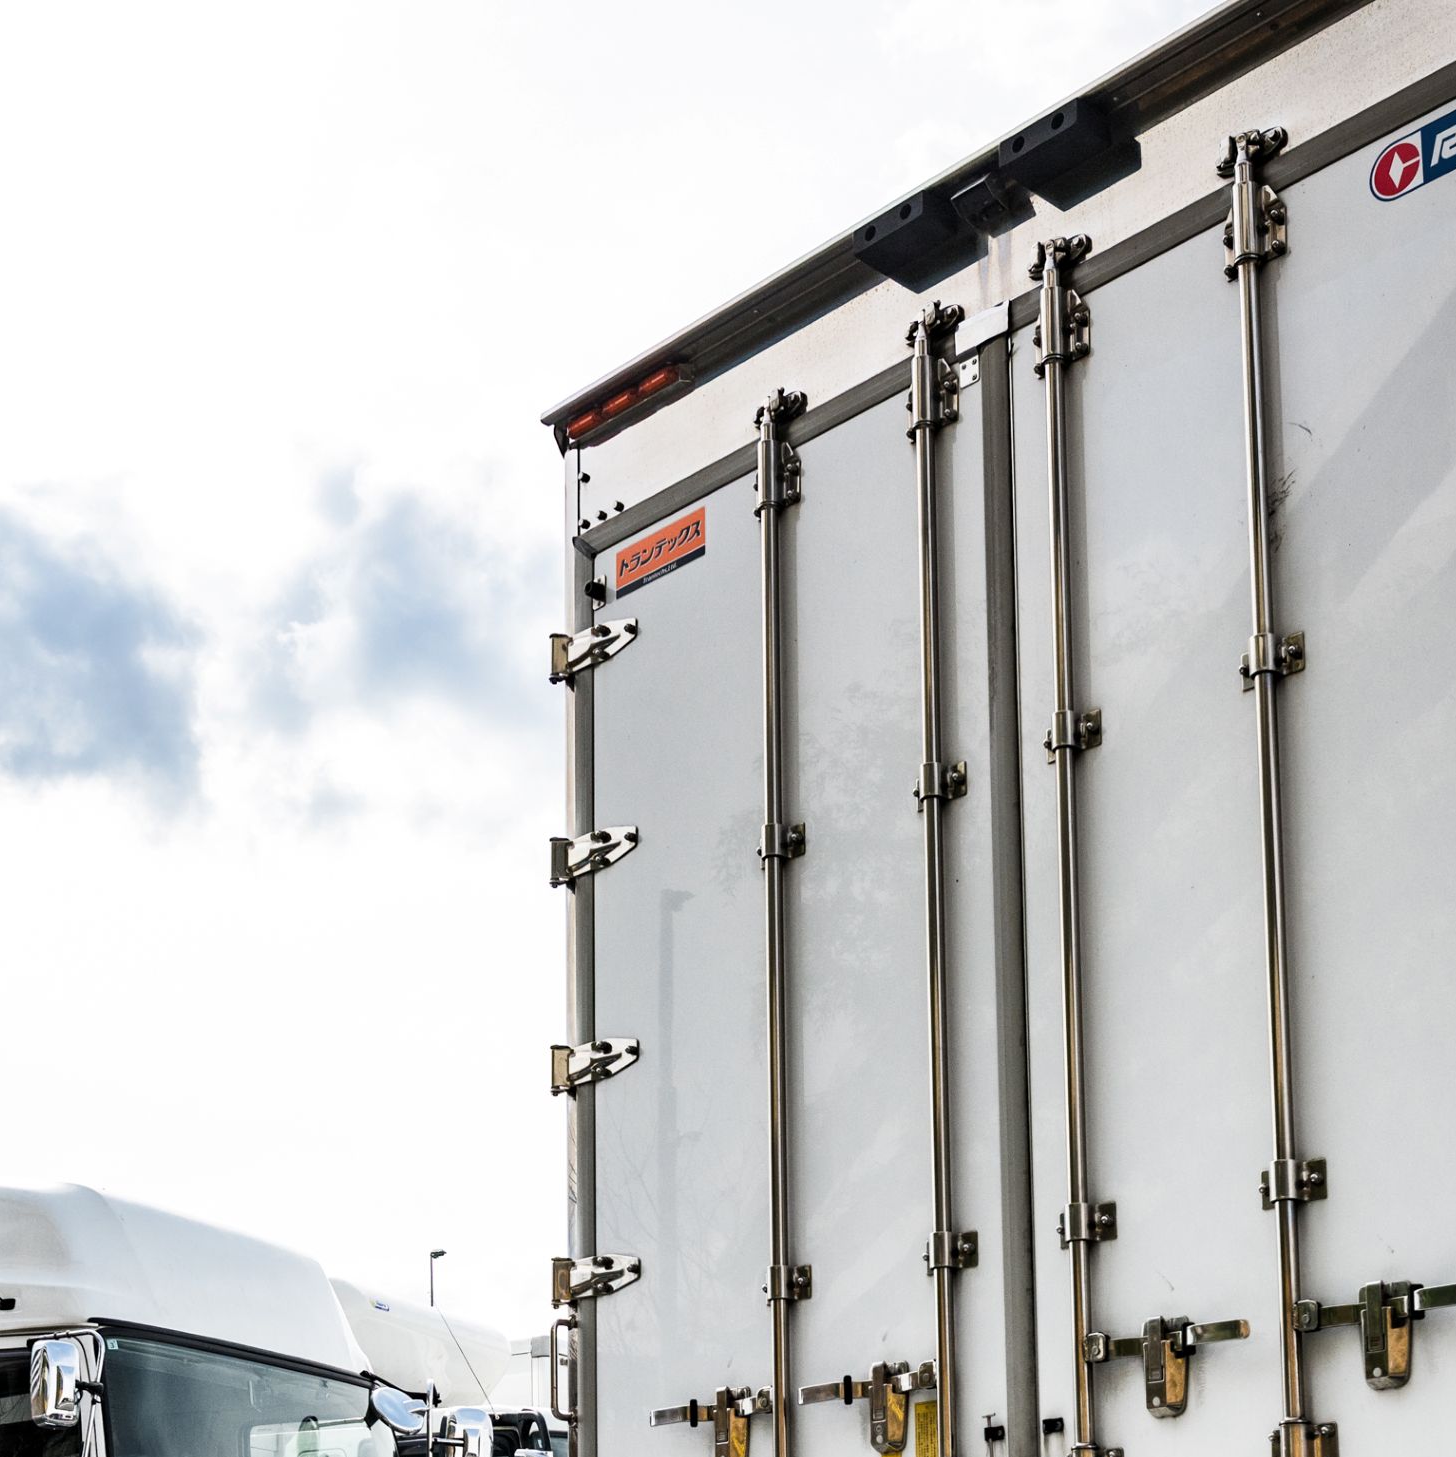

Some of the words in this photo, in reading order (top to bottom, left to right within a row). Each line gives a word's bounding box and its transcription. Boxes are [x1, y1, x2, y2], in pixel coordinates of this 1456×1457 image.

[619, 519, 702, 577] トランテックス
